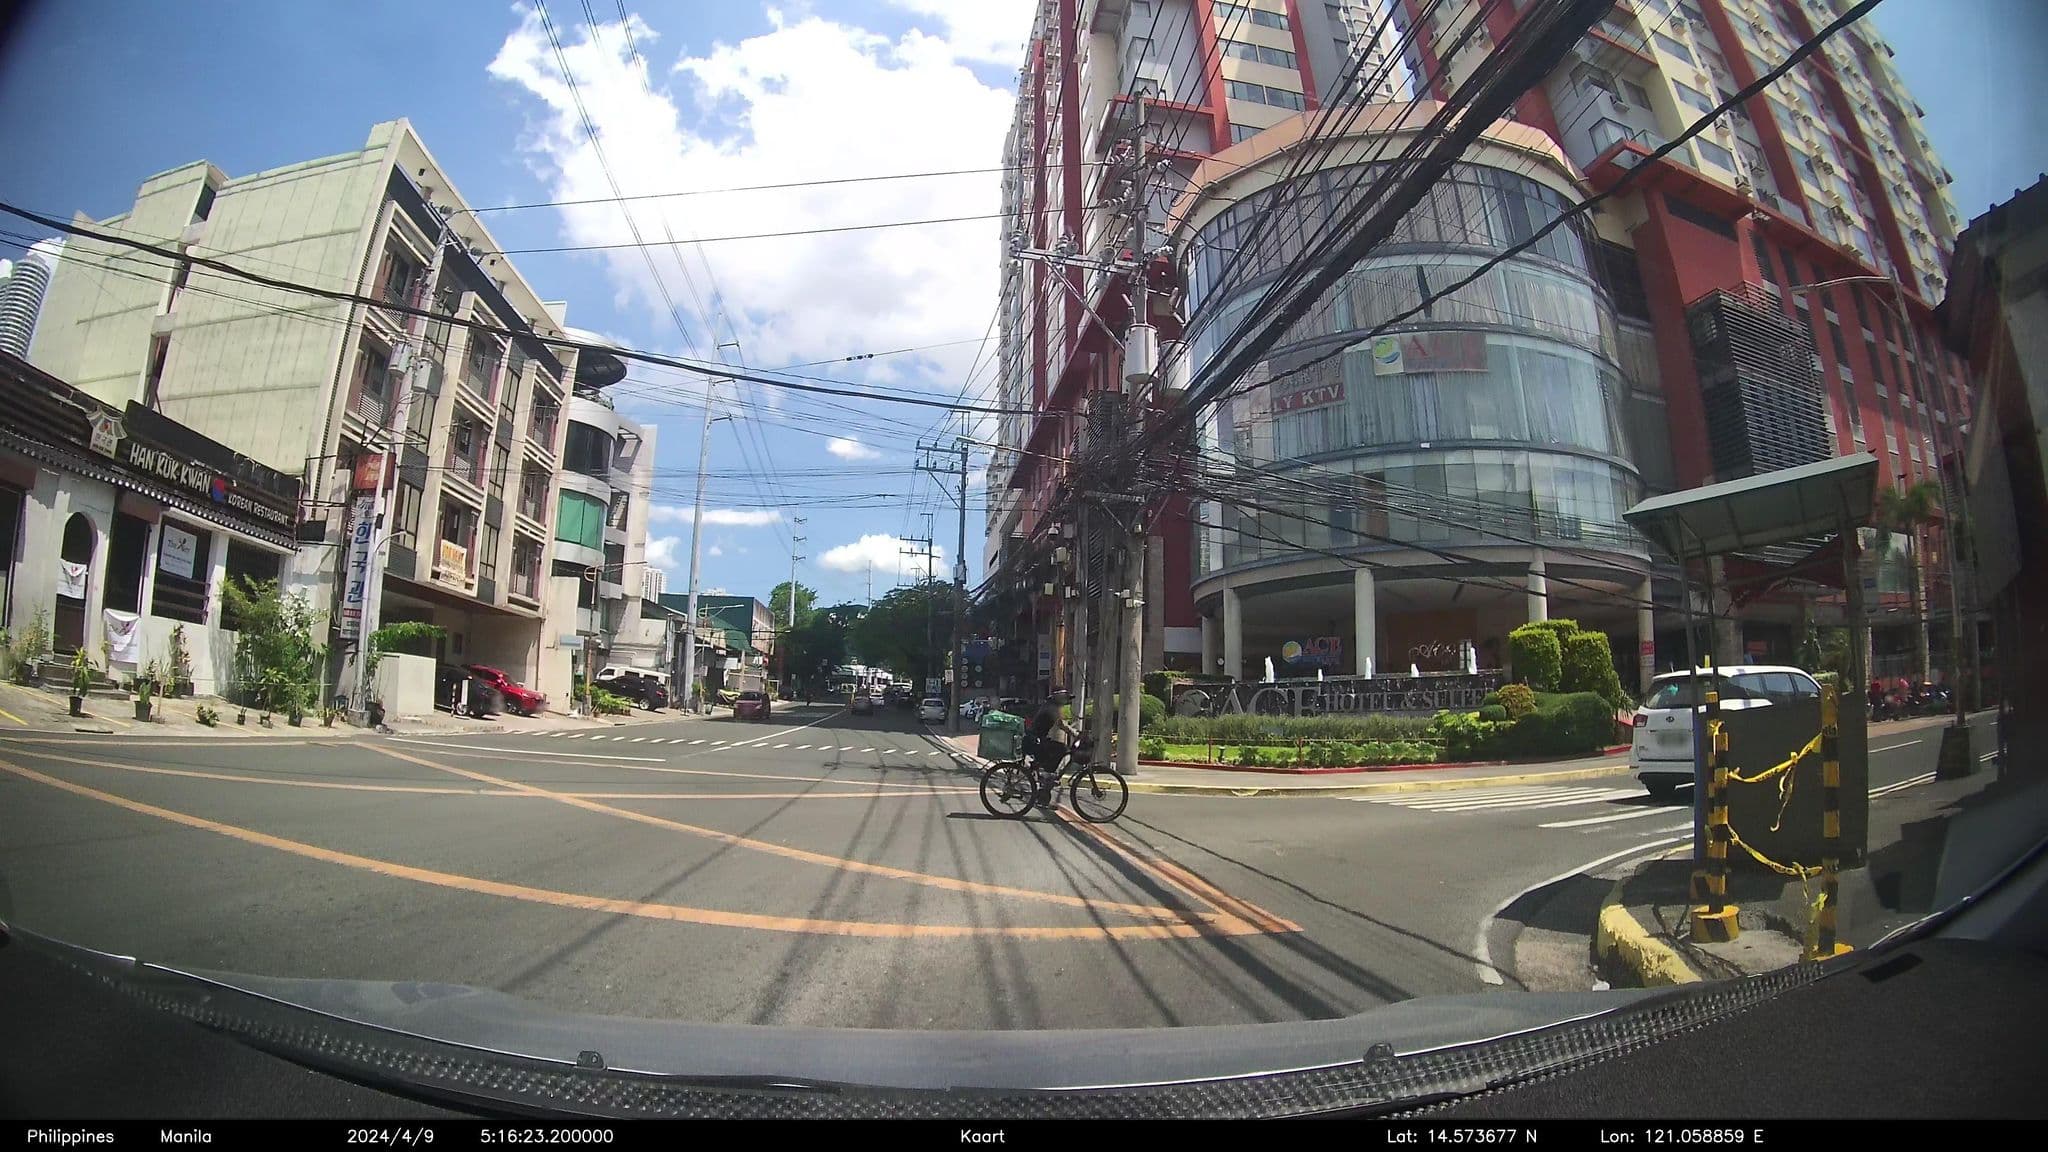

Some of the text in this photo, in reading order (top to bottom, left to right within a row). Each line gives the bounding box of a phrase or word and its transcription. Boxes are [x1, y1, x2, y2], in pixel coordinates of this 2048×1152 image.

[1302, 384, 1339, 405] KTV
[129, 442, 155, 471] HAN
[227, 494, 289, 526] KOREAN RESTAURANT
[347, 521, 373, 603] 한국관
[1304, 636, 1341, 655] ACE
[1220, 687, 1328, 716] ACE
[1324, 692, 1395, 712] HOTEL
